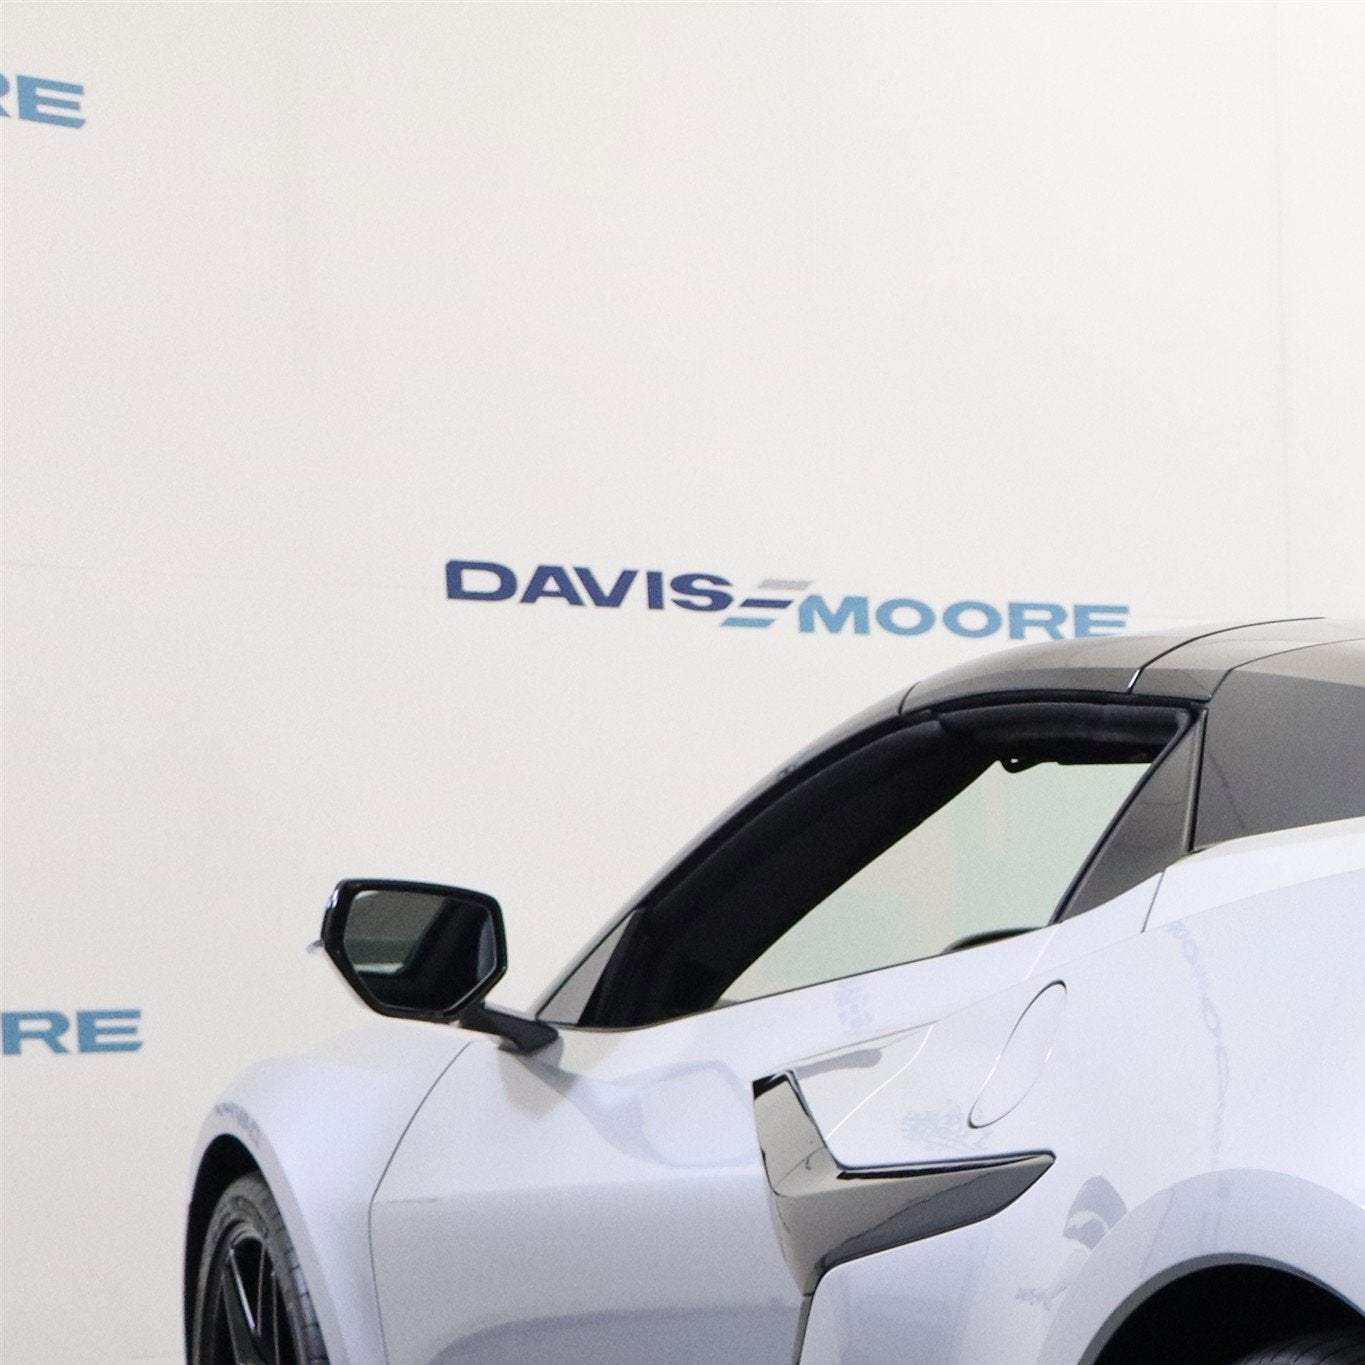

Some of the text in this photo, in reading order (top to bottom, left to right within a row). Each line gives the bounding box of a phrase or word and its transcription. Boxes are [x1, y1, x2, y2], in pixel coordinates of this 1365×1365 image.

[0, 73, 86, 128] E
[446, 560, 1129, 640] DAVIS MOORE
